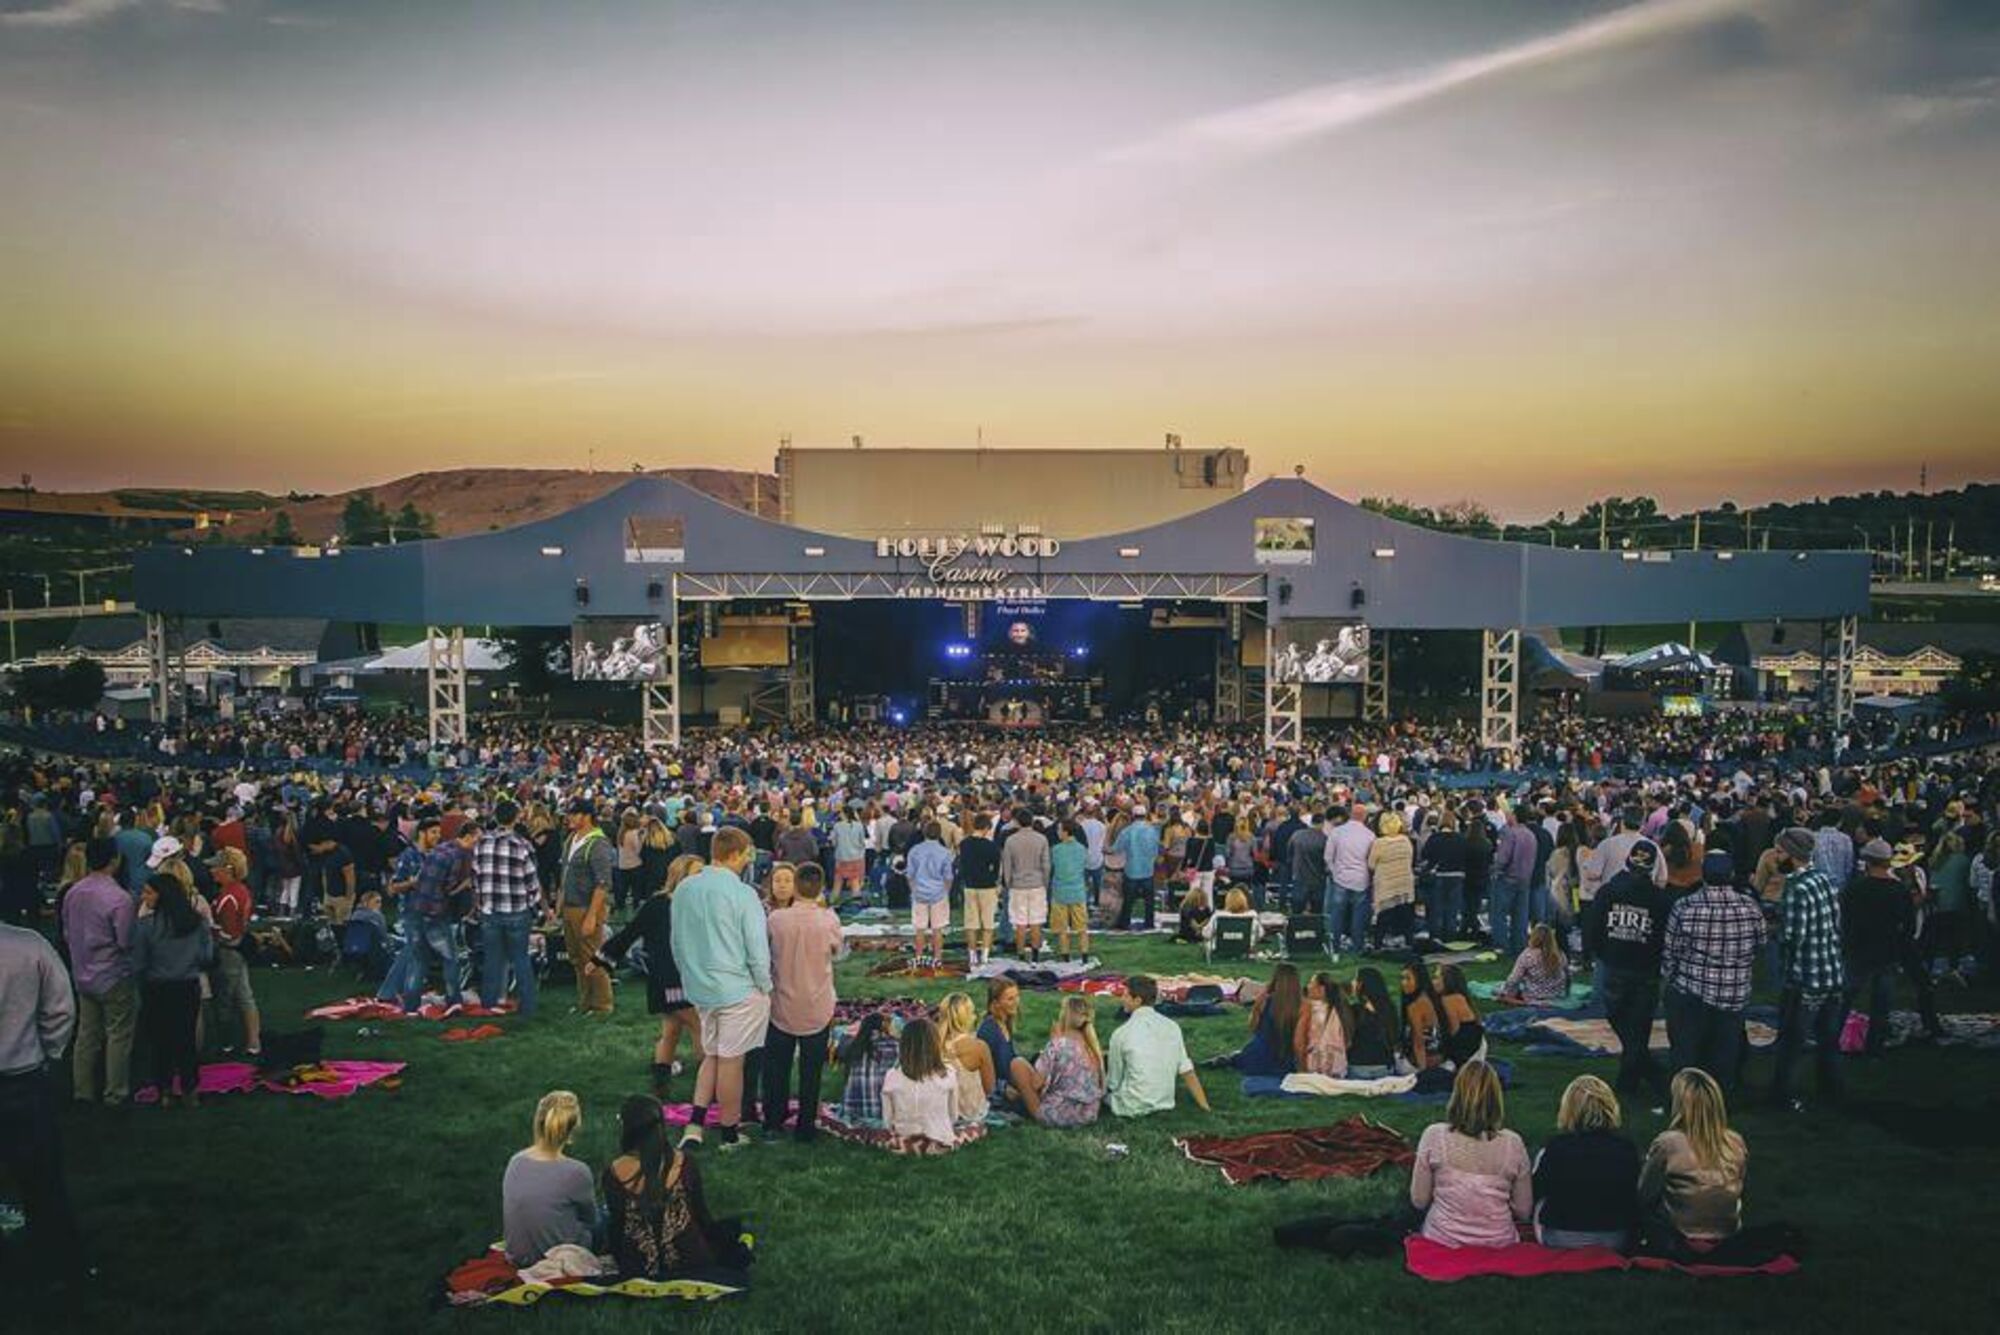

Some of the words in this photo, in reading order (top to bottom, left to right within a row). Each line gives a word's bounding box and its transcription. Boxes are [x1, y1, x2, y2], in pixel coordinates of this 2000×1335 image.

[877, 536, 1060, 557] HOLLYWOOD
[927, 553, 1008, 582] Casino
[896, 587, 1042, 599] AMPHITHEATRE
[1607, 911, 1652, 934] FIRE
